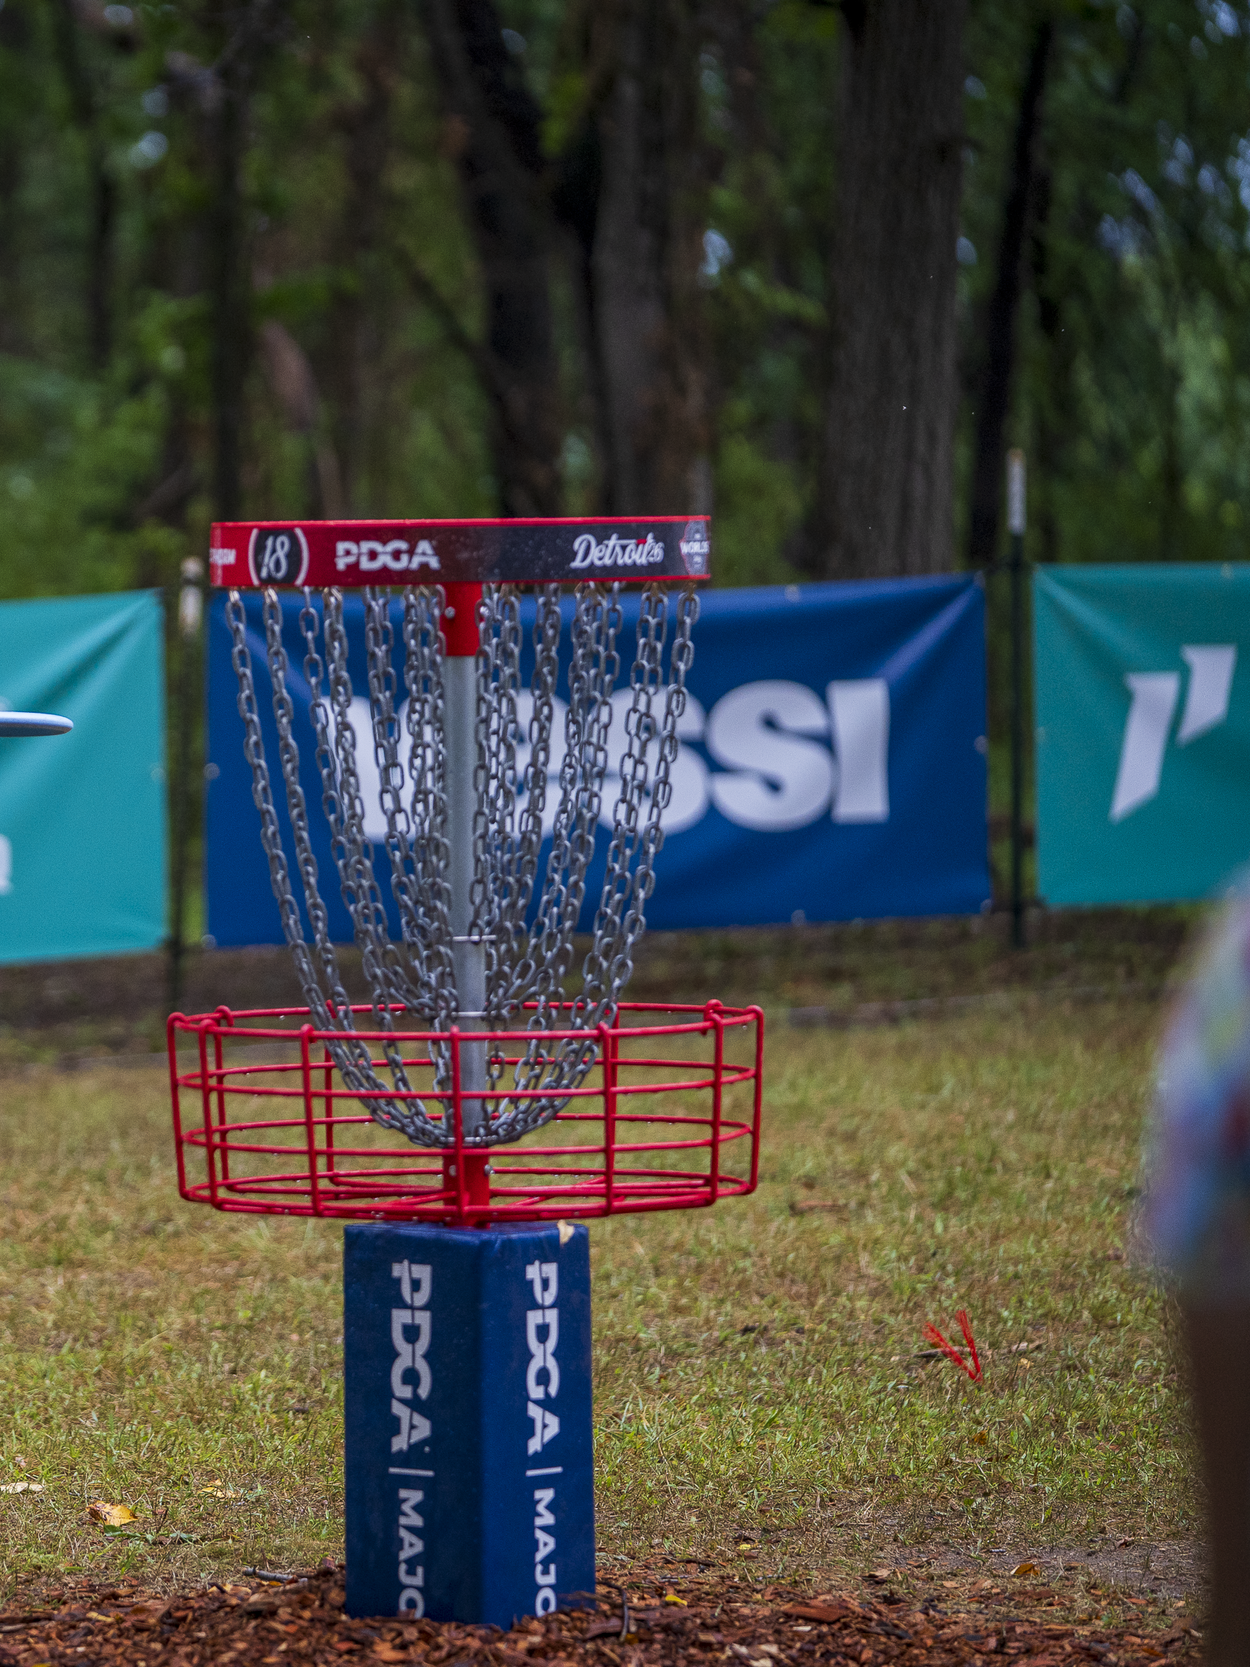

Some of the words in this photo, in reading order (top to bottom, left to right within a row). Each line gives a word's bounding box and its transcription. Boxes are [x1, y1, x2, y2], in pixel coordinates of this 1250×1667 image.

[260, 535, 292, 580] 18
[335, 539, 441, 572] PDGA
[569, 532, 656, 569] Detroit
[390, 1259, 433, 1454] PDGA
[525, 1259, 561, 1456] PDGA
